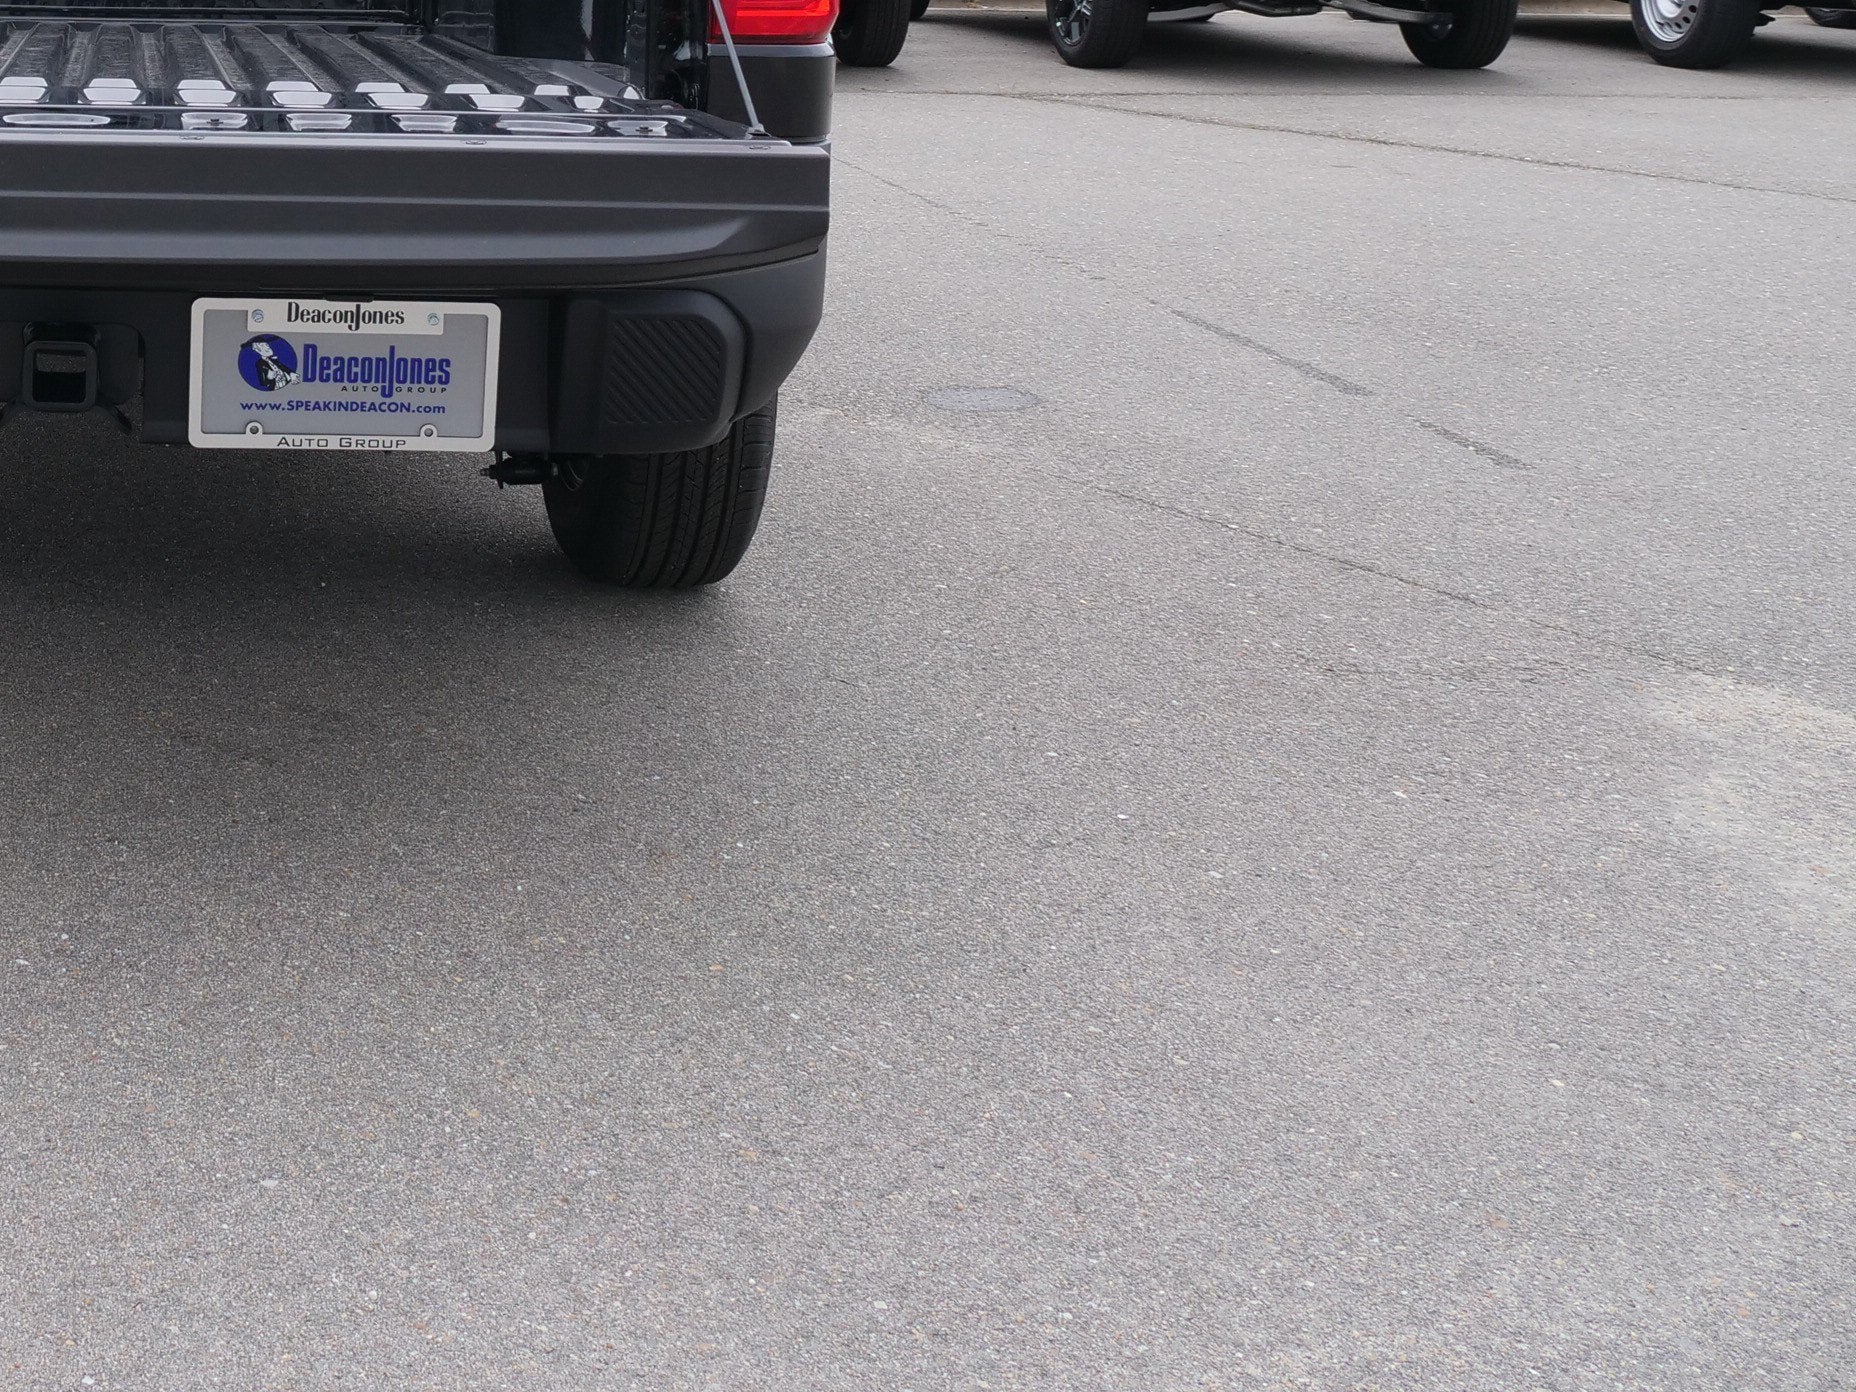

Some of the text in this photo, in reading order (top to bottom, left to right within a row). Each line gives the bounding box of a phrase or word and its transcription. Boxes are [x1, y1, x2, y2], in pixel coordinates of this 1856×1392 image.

[340, 384, 448, 394] AUTO GROUP
[239, 399, 446, 415] www.SPEAKINDEACON.com
